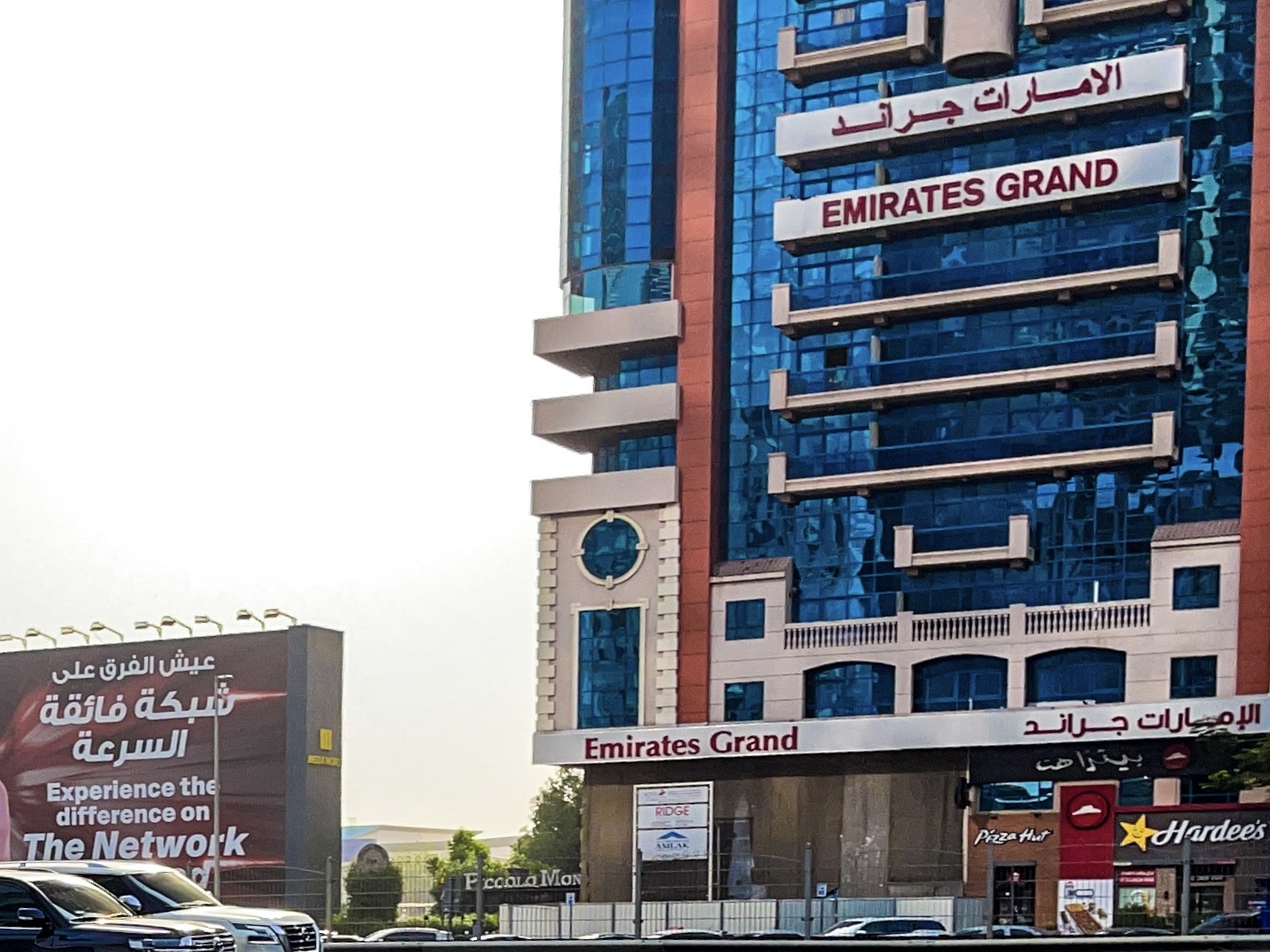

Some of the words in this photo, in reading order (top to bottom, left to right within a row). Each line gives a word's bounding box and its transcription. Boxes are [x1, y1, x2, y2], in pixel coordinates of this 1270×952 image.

[831, 98, 964, 136] جراند
[821, 177, 986, 229] EMIRATES
[995, 157, 1119, 201] GRAND
[98, 654, 155, 682] الفرق
[158, 648, 216, 678] عيش
[38, 693, 128, 727] فائقة
[134, 681, 237, 725] شبكة
[1023, 712, 1129, 738] جراند
[71, 728, 189, 768] السرعة
[584, 734, 701, 760] Emirates
[709, 726, 799, 754] Grand
[46, 779, 175, 805] Experience
[179, 775, 218, 796] the
[55, 806, 176, 827] difference
[180, 804, 210, 822] on
[655, 805, 690, 816] RIDGE
[23, 832, 85, 860] The
[91, 825, 250, 861] Network
[973, 828, 1017, 846] Pizza
[1019, 828, 1052, 843] Hut
[1150, 819, 1268, 846] Hardee's
